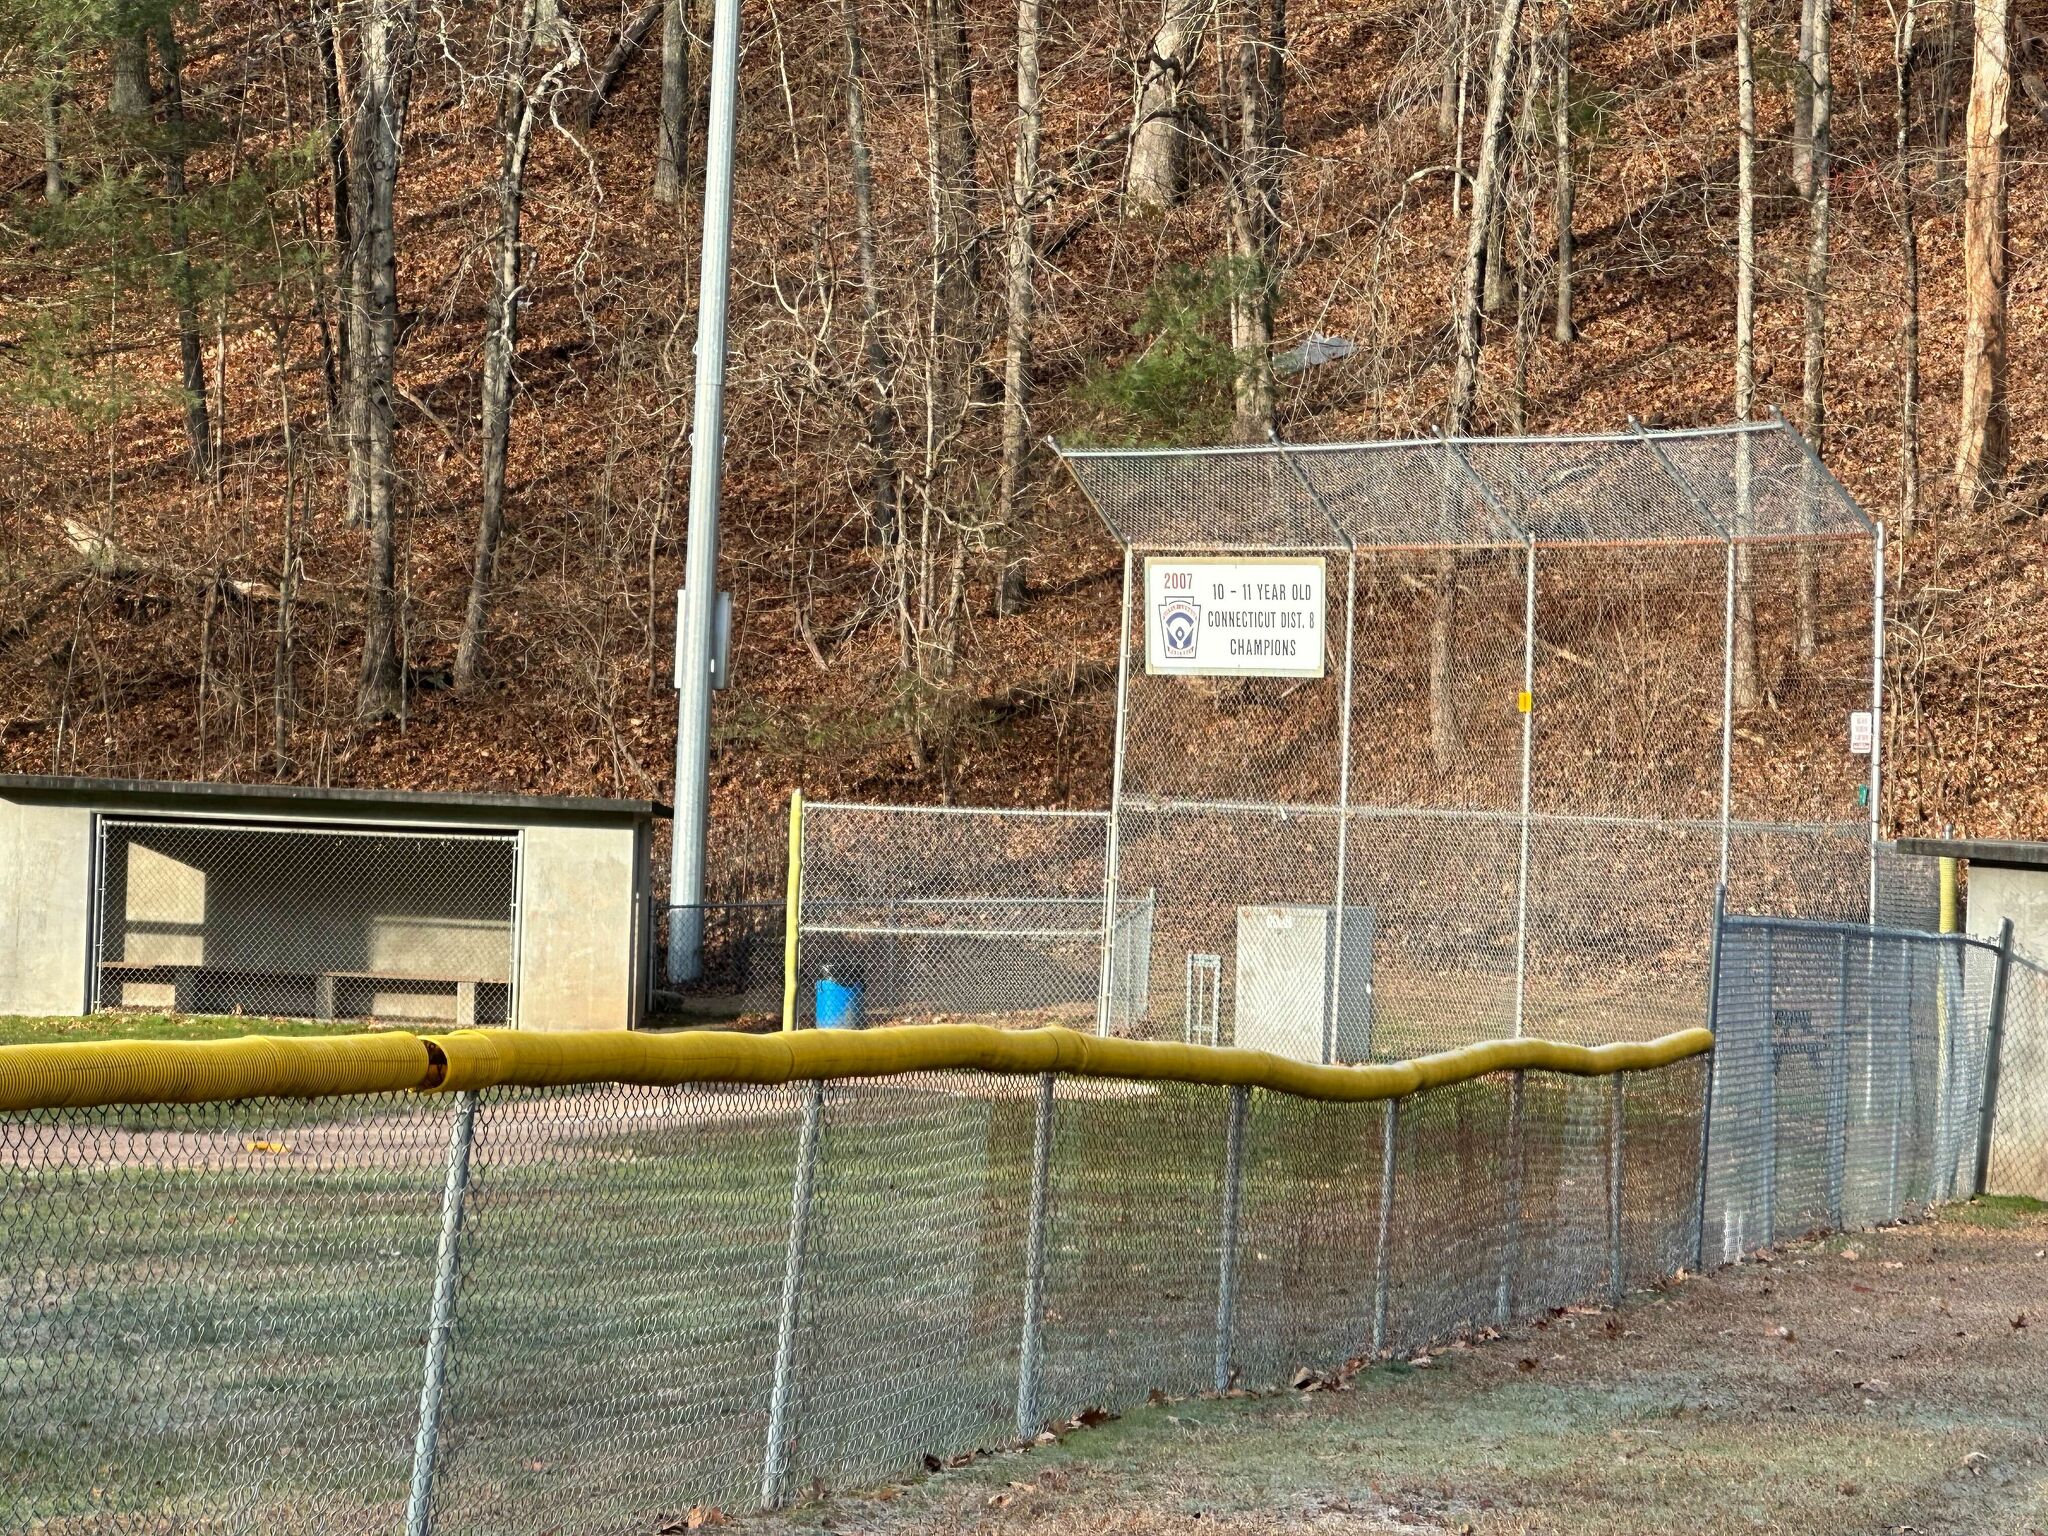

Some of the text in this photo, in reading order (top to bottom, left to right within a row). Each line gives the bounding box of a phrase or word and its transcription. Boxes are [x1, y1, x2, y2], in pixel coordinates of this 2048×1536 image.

[1164, 573, 1193, 590] 2007
[1212, 584, 1225, 600] 10
[1242, 584, 1252, 600] 11
[1257, 584, 1286, 601] YEAR
[1291, 584, 1312, 601] OLD
[1207, 611, 1276, 628] CONNECTICUT
[1280, 612, 1305, 629] DIST.
[1230, 639, 1297, 656] CHAMPIONS
